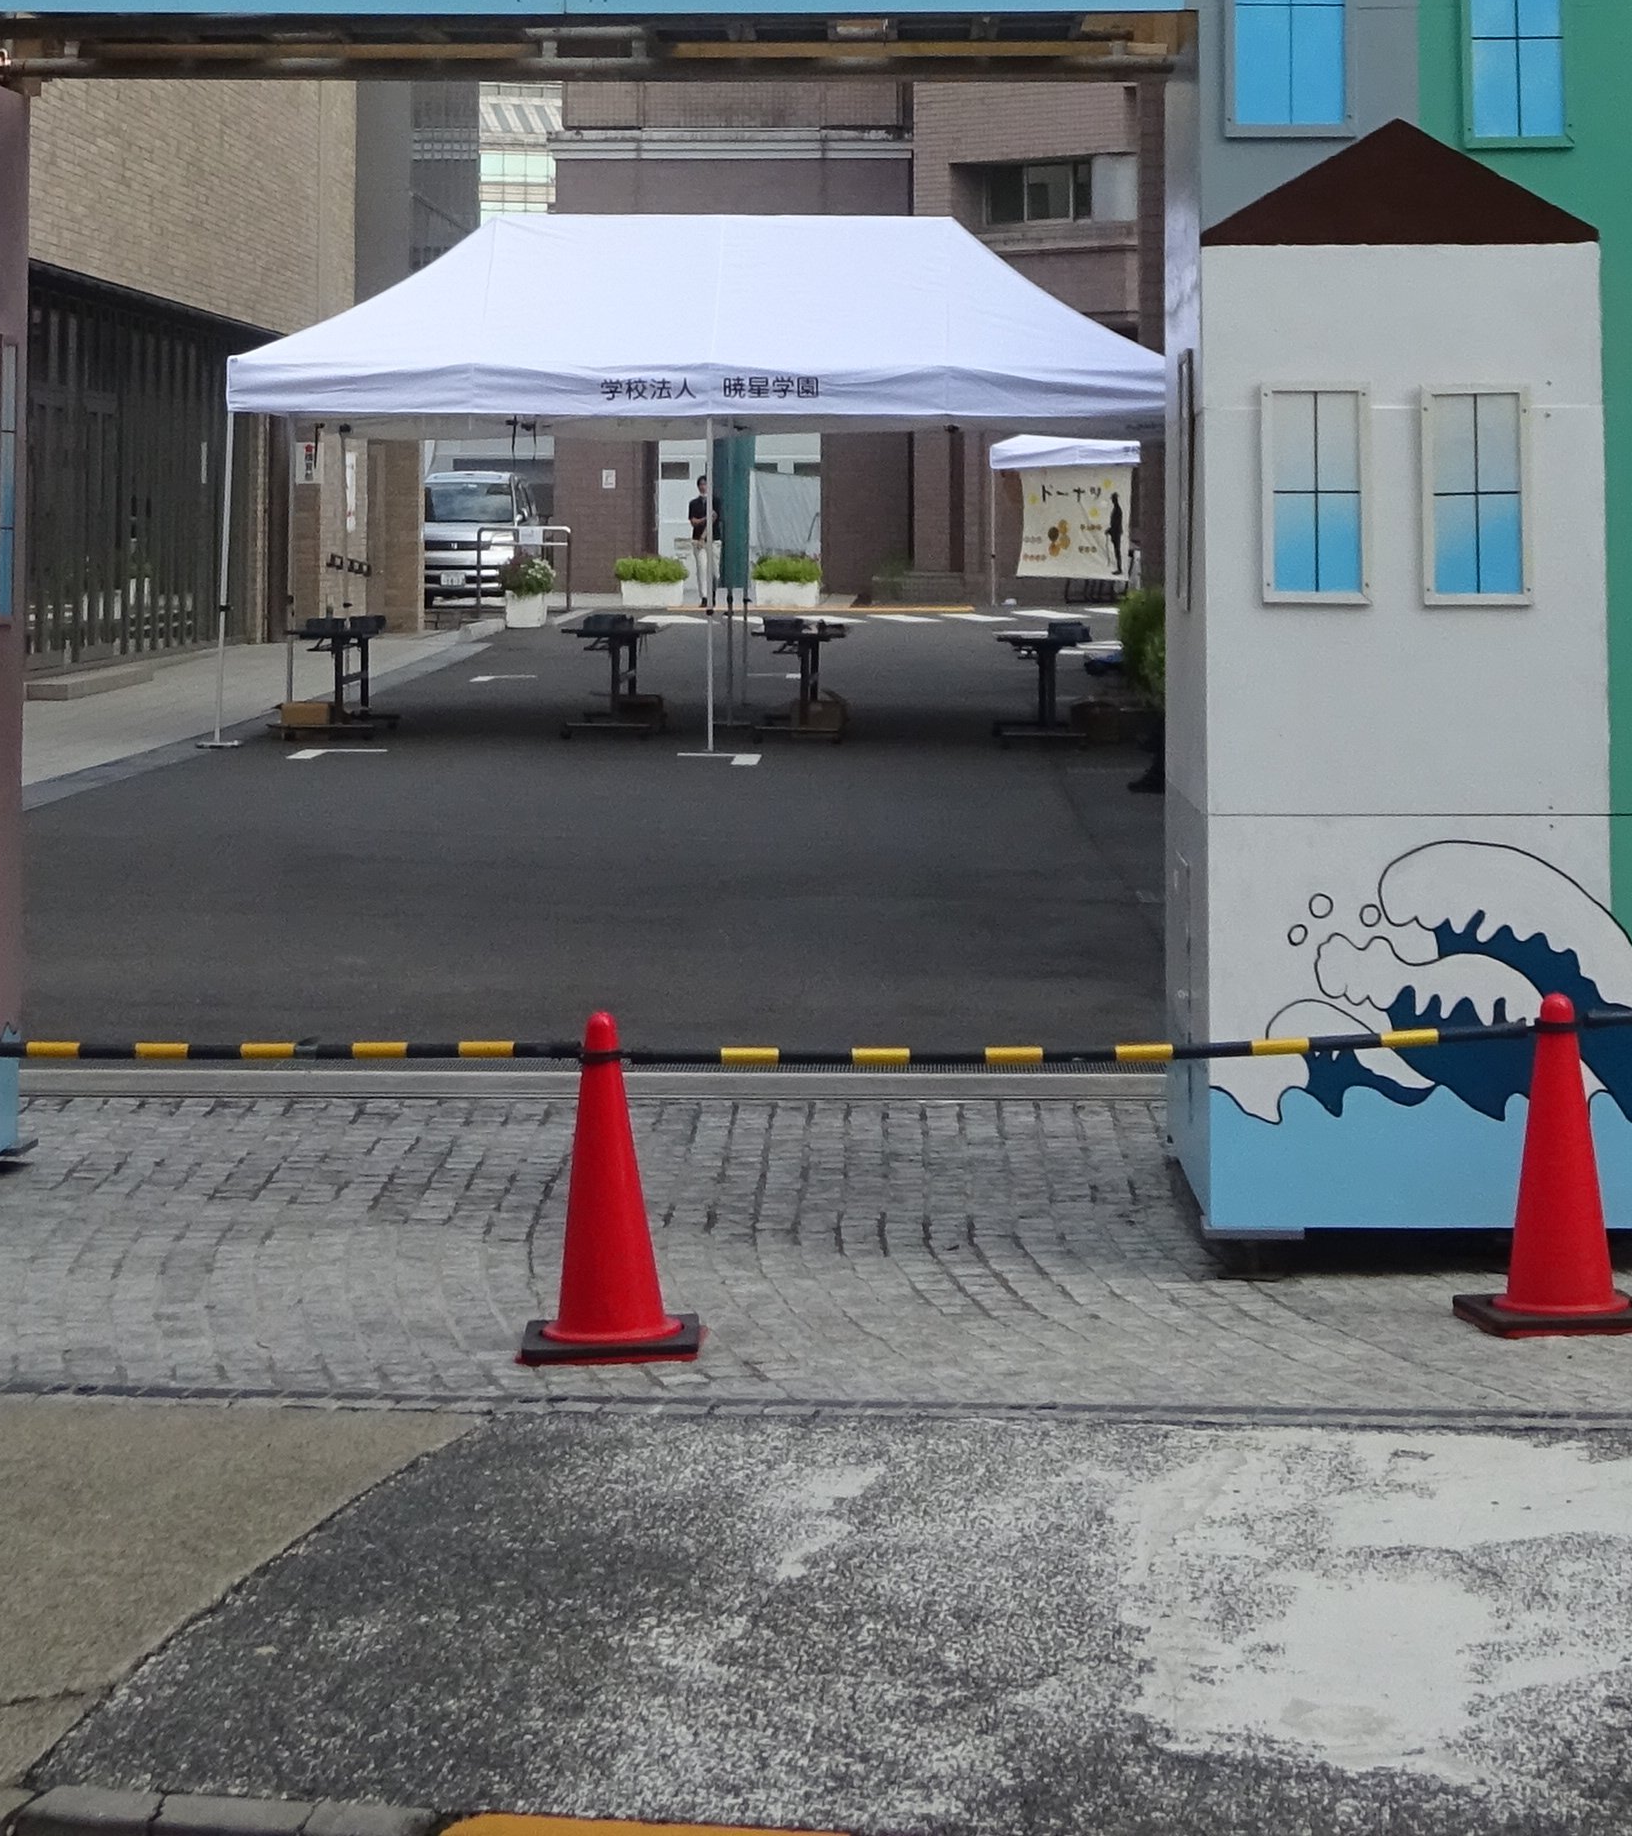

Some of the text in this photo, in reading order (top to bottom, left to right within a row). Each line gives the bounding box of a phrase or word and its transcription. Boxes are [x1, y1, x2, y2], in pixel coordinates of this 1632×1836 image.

[600, 376, 820, 401] 学校法人 暁星学園
